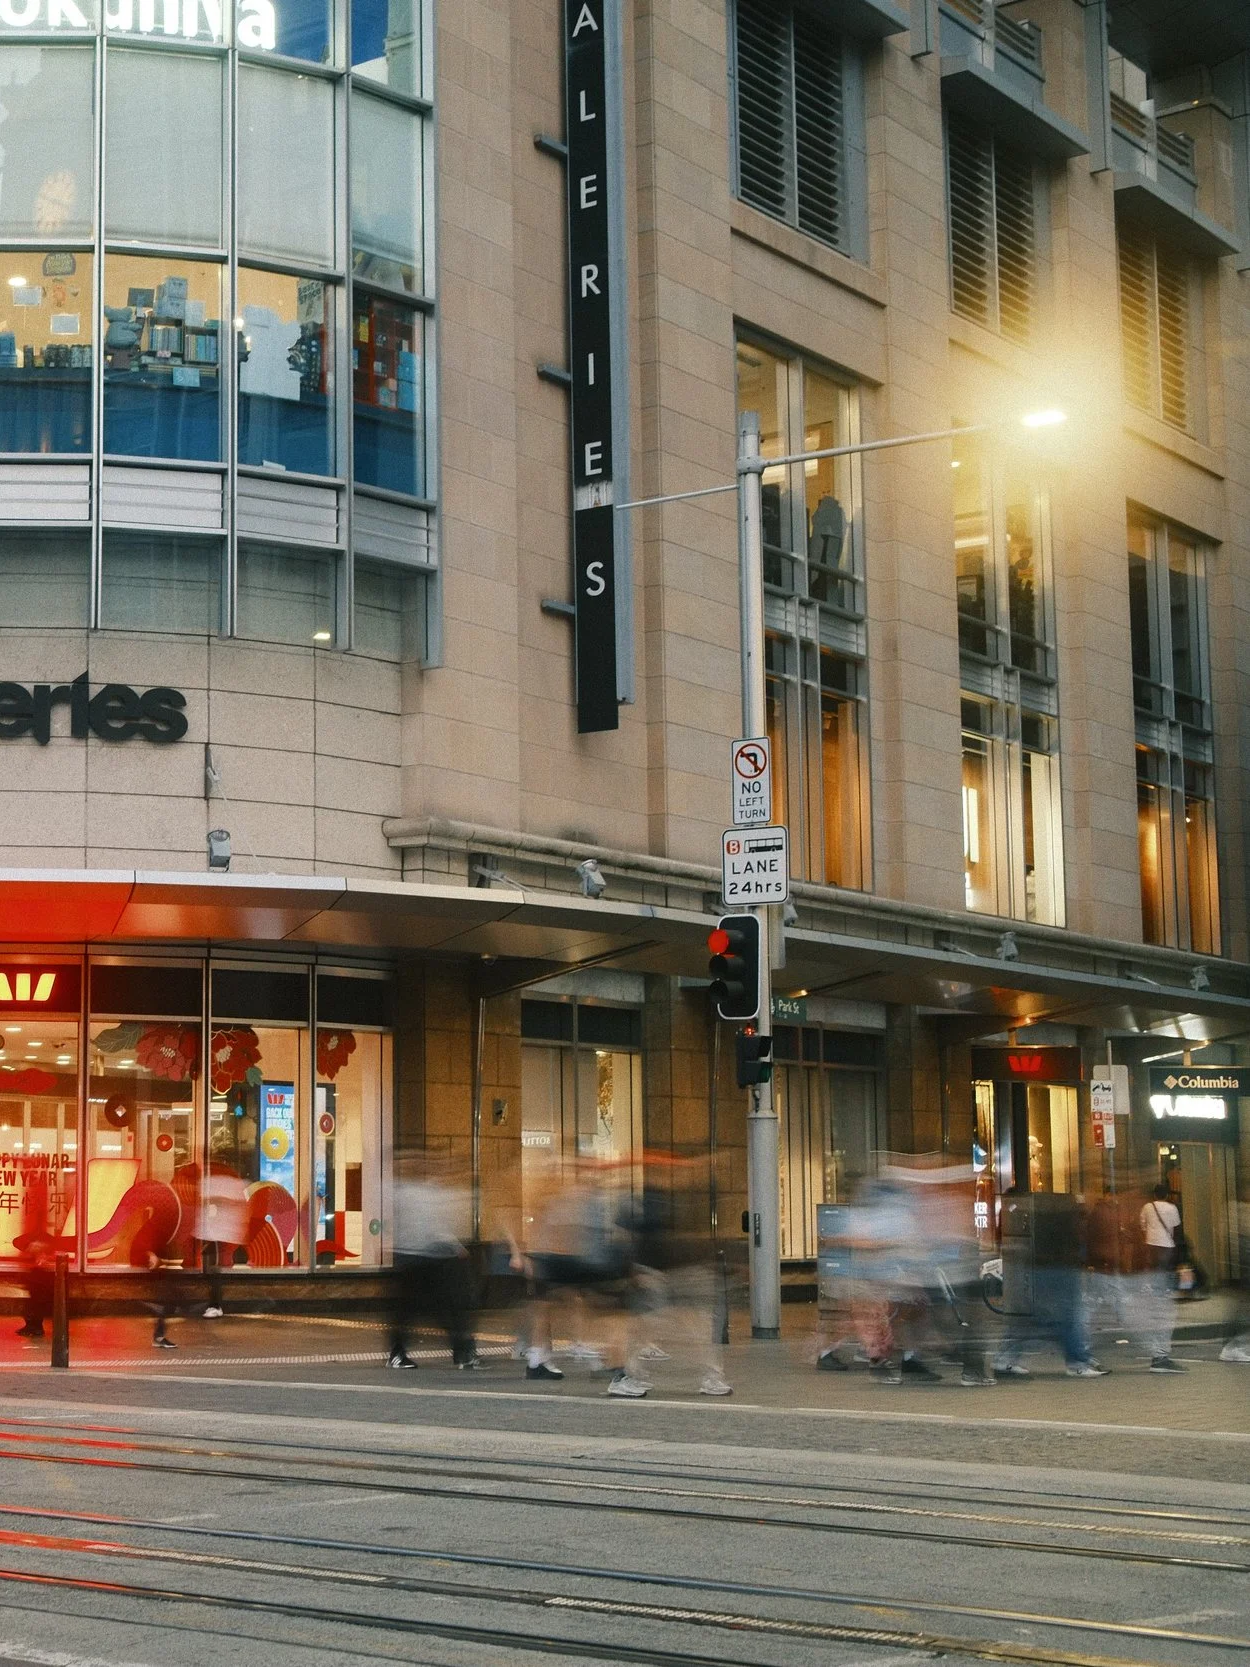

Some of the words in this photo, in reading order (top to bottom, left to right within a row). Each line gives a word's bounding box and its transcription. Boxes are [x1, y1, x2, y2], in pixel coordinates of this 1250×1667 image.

[741, 781, 761, 794] NO
[739, 796, 764, 807] LEFT
[738, 808, 766, 819] TURN
[732, 859, 778, 876] LANE
[729, 880, 782, 896] 24hrs
[778, 999, 792, 1012] Park
[1177, 1075, 1239, 1089] Columbia
[20, 1171, 57, 1187] YEAR
